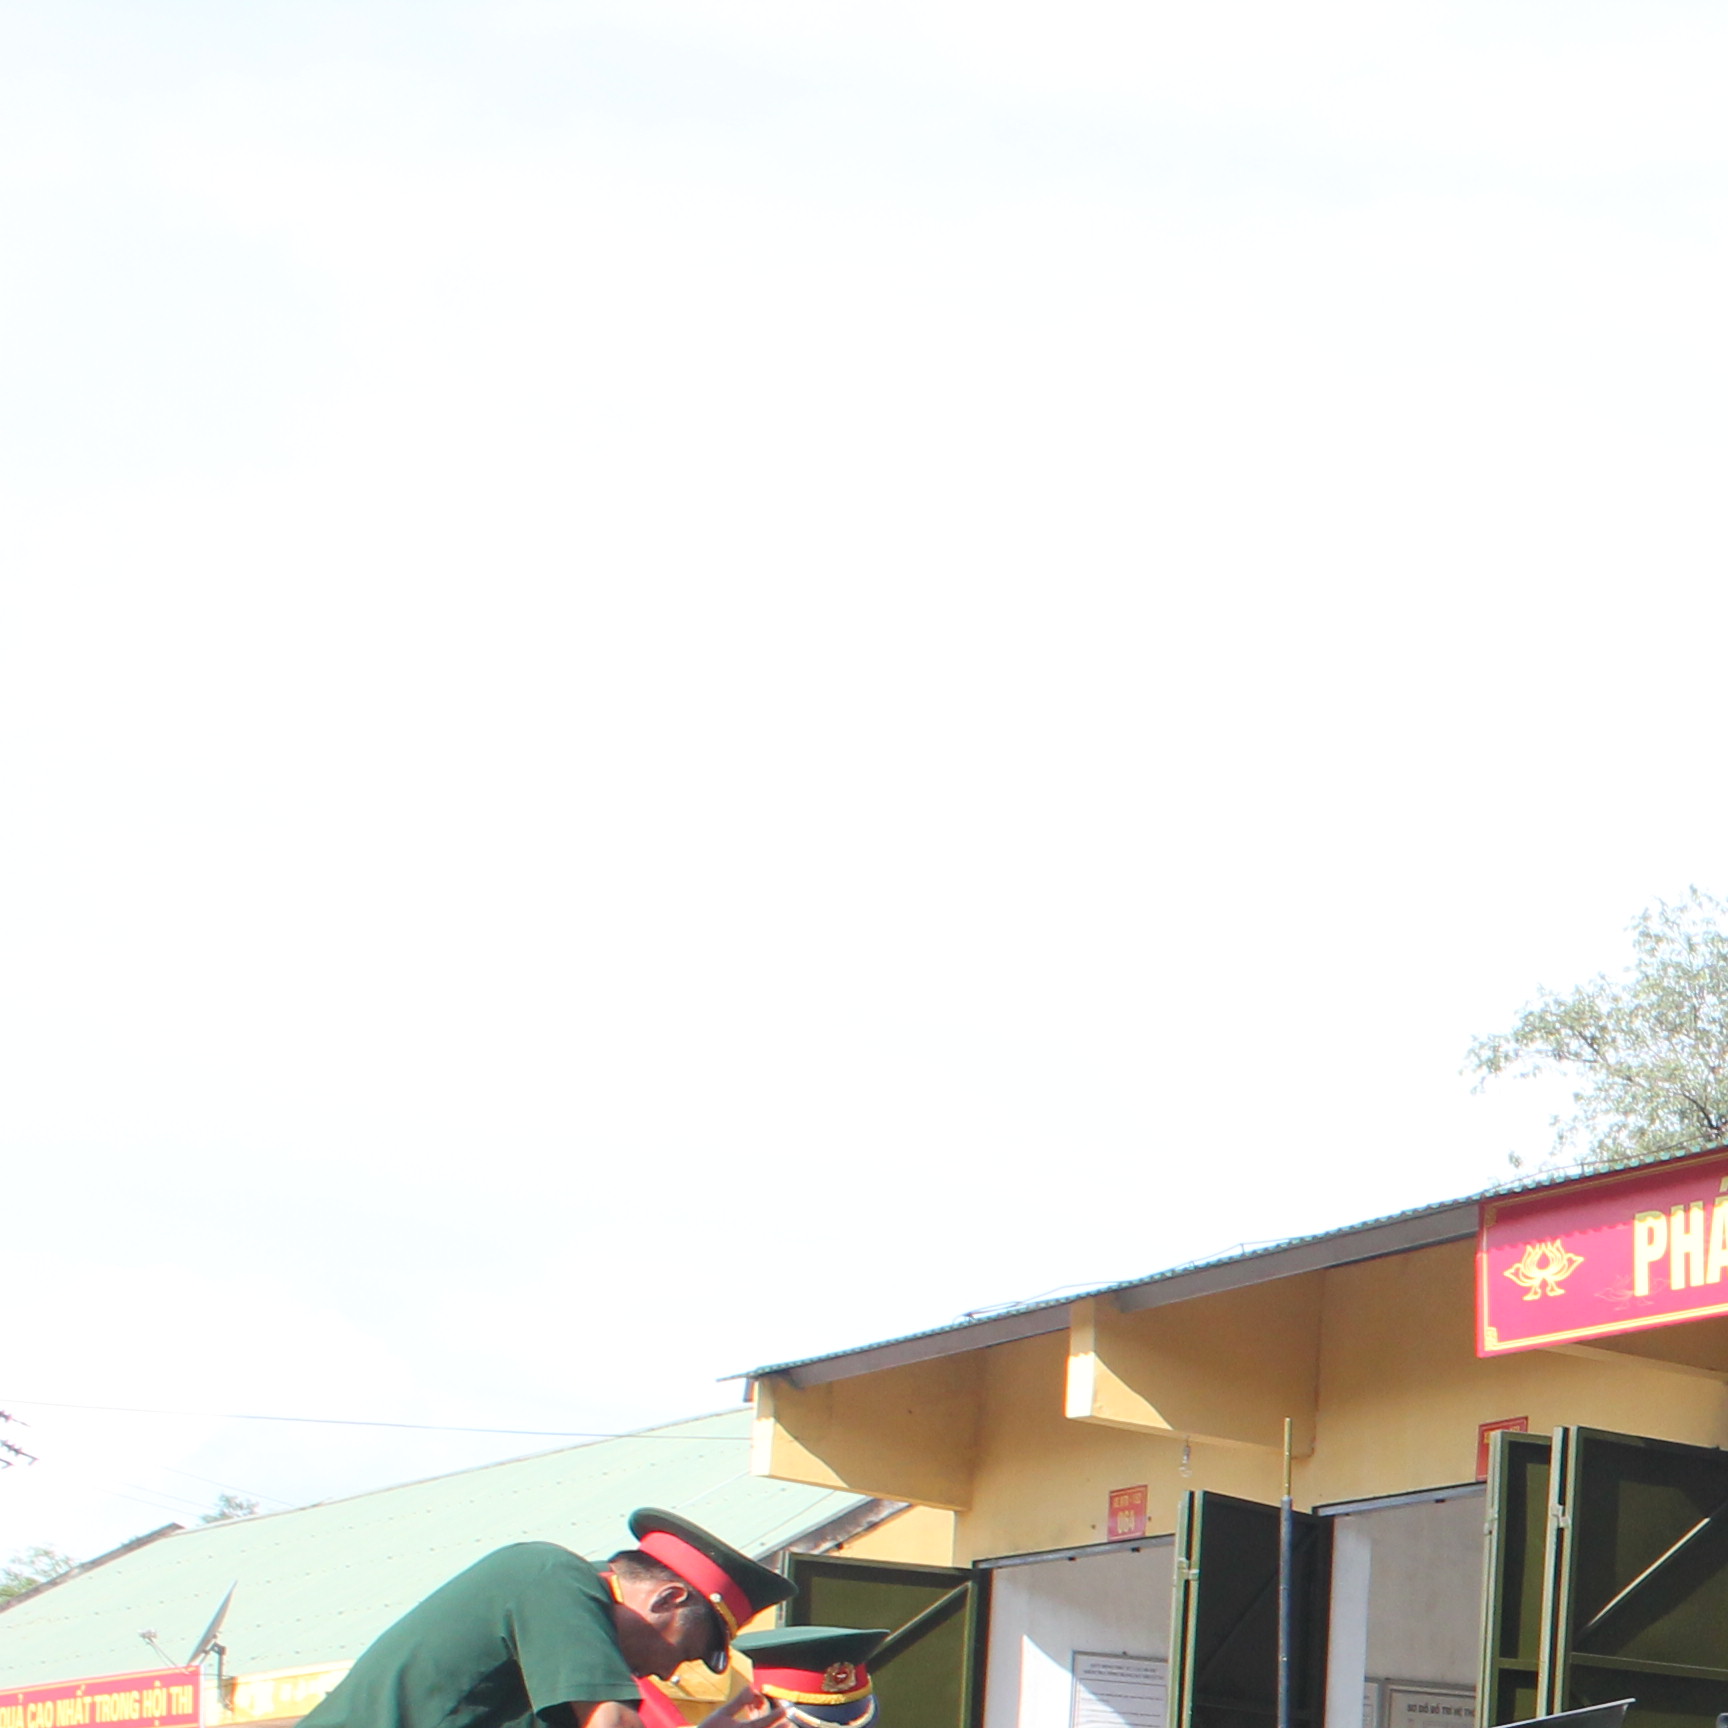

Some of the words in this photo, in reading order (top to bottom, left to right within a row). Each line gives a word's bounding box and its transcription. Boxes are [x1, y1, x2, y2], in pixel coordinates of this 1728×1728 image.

[55, 1684, 92, 1727] NHẤT
[94, 1690, 141, 1723] TRONG
[142, 1680, 167, 1727] HỘI
[169, 1685, 193, 1716] THI
